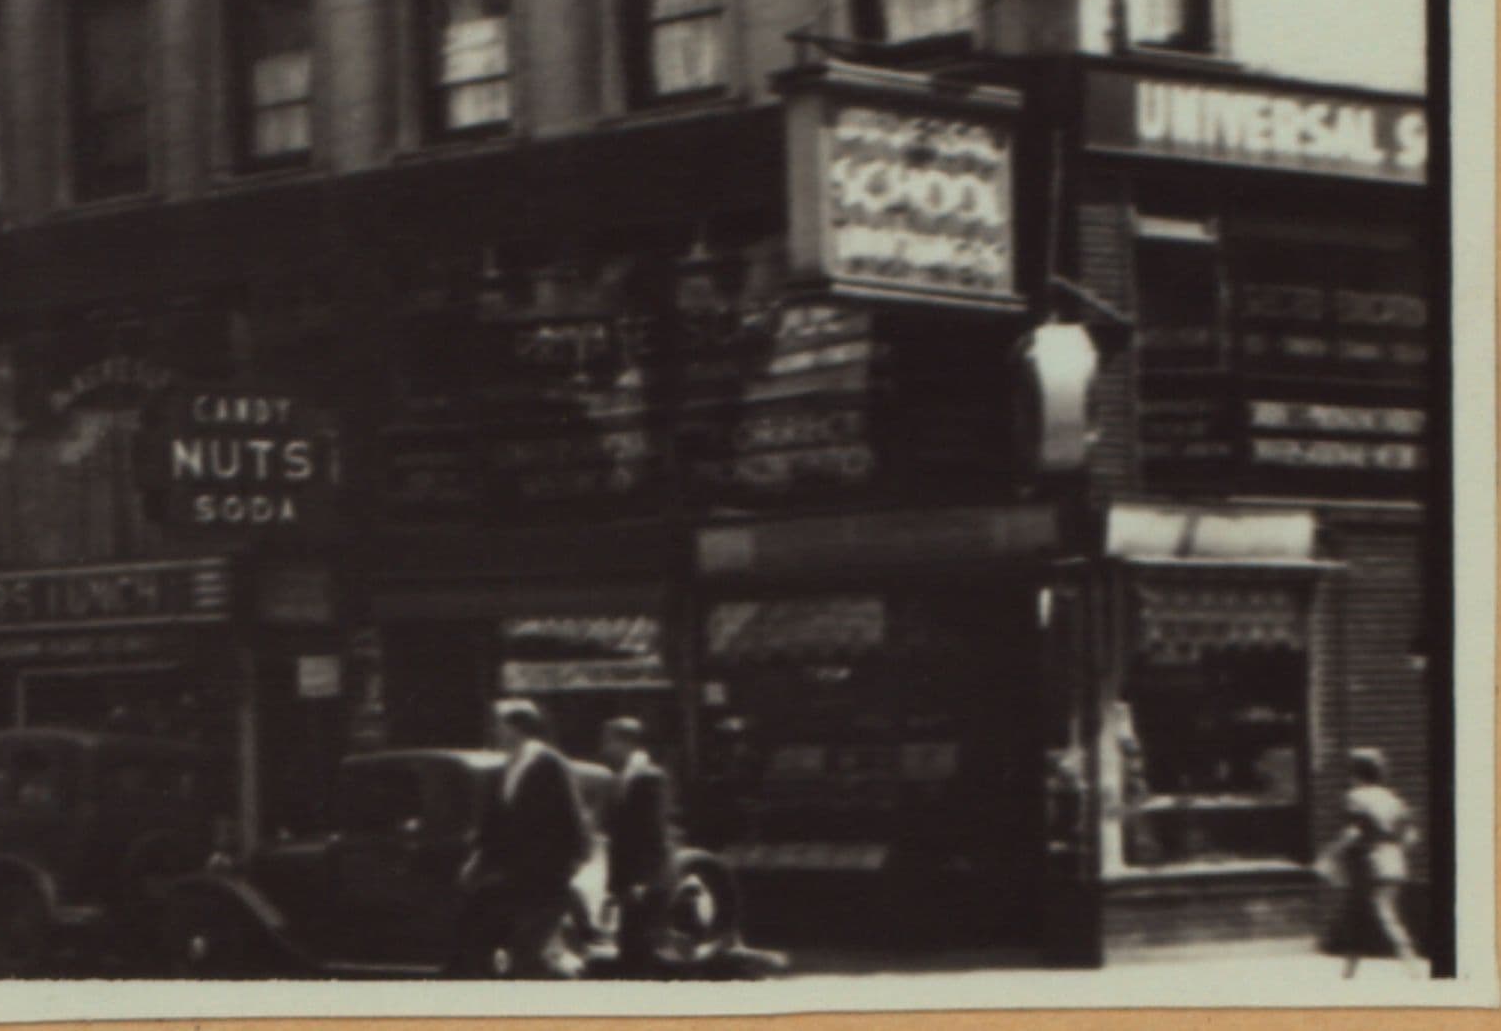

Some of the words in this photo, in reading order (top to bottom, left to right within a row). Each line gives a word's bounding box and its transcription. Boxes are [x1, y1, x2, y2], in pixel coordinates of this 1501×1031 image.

[1134, 79, 1386, 164] UNIVERSAL
[191, 394, 294, 425] CANDY
[170, 438, 315, 481] NUTS
[193, 493, 298, 524] SODA
